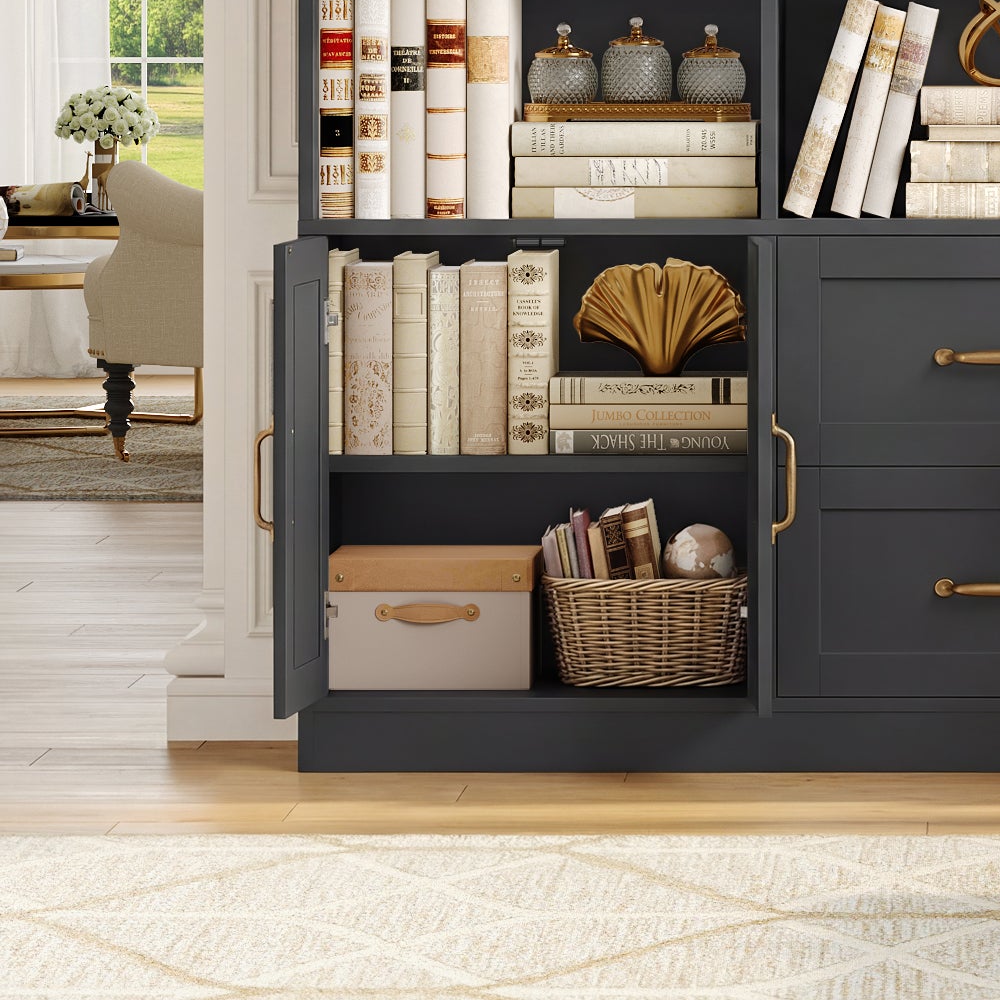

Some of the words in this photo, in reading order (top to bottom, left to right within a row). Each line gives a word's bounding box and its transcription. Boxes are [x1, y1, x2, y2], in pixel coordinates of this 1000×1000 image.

[976, 90, 989, 124] POEMS
[592, 410, 632, 423] JUMBO
[635, 409, 711, 421] COLLECTION
[591, 434, 635, 450] SHACK
[640, 434, 666, 450] THE
[682, 436, 729, 450] YOUNG
